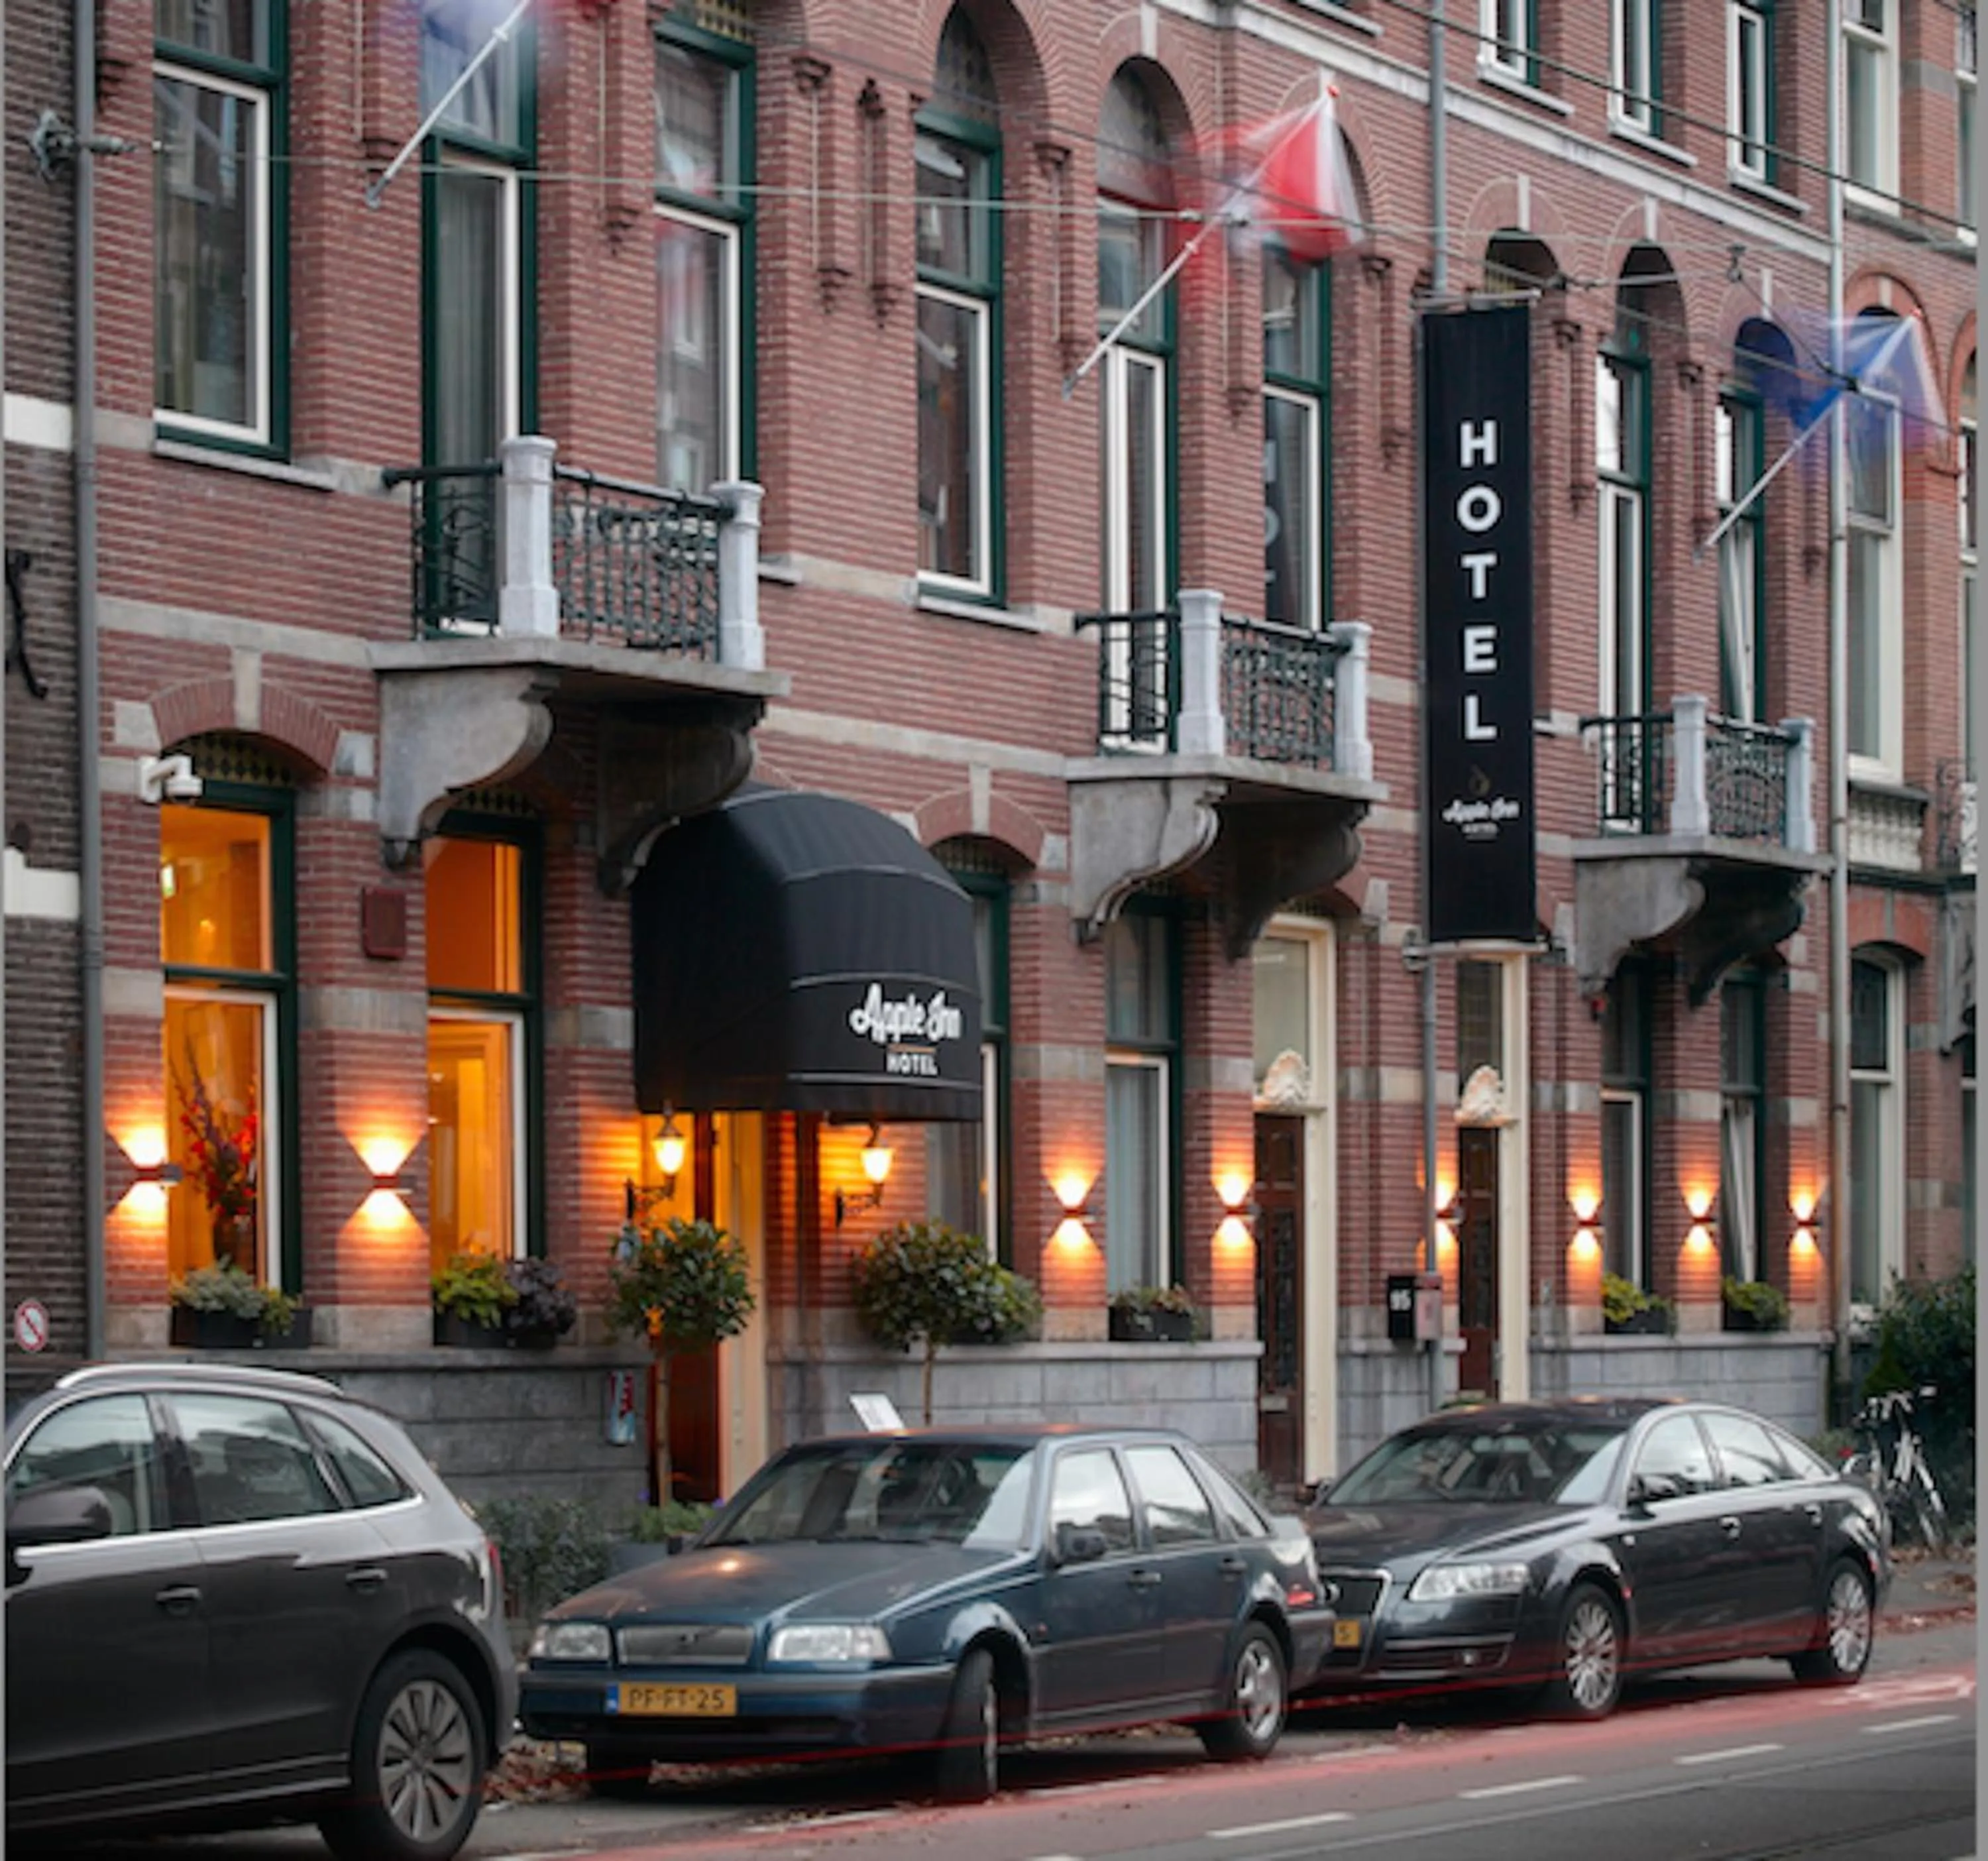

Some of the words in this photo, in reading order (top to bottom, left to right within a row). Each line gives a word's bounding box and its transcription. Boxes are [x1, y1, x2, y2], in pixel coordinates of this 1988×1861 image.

[1457, 420, 1501, 739] HOTEL
[849, 983, 926, 1043] Apple
[926, 991, 960, 1041] Inn
[887, 1054, 938, 1075] HOTEL
